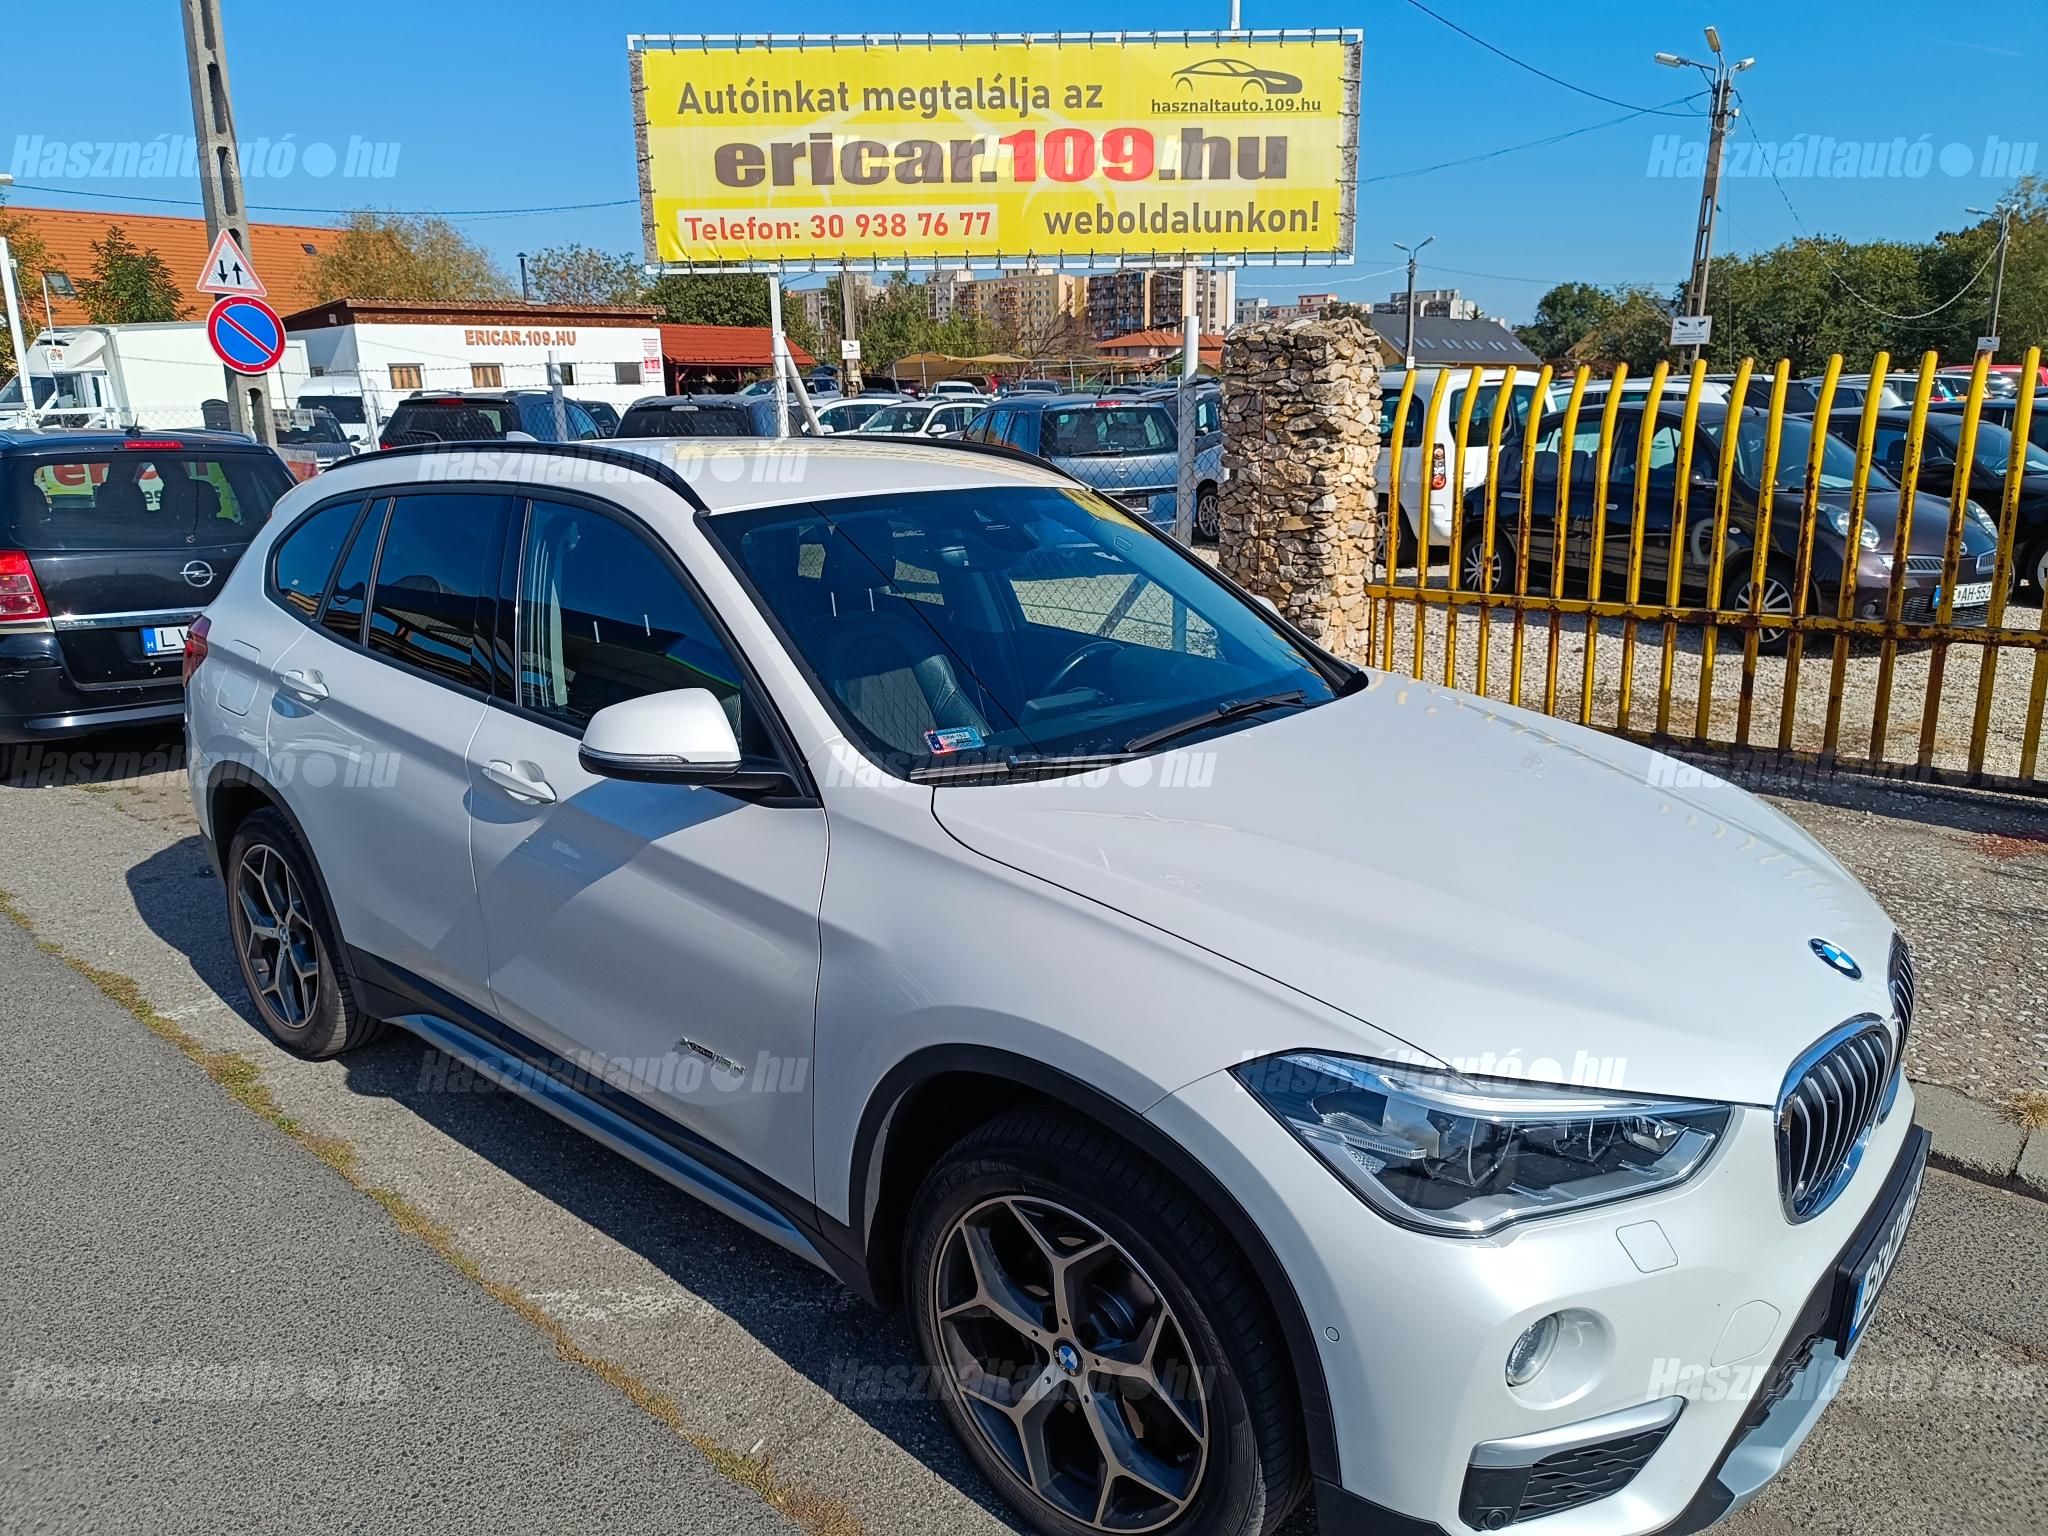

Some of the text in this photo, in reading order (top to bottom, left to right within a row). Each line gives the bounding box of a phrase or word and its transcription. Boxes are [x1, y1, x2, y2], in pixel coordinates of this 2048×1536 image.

[677, 76, 1103, 120] Autóinkat megtalálja az
[1150, 97, 1322, 114] hasznaltauto.109.hu
[714, 127, 1288, 188] ericar.109.hu
[684, 212, 991, 242] Telefon: 30 938 76 77
[1043, 201, 1320, 237] weboldalunkon!
[465, 329, 577, 346] ERICAR.109.HU
